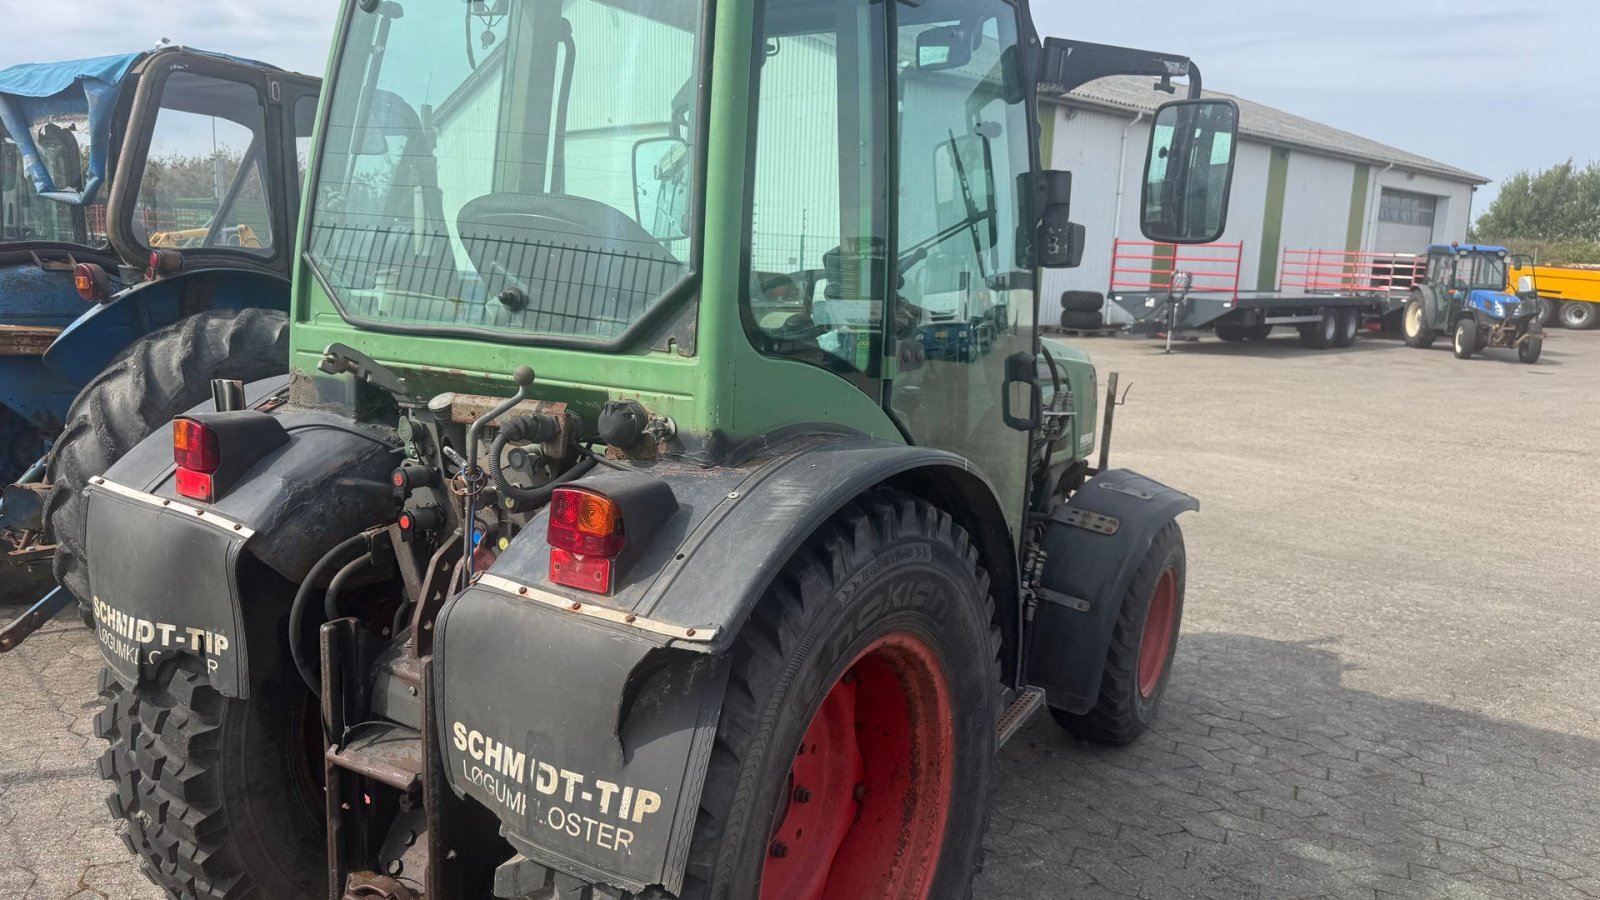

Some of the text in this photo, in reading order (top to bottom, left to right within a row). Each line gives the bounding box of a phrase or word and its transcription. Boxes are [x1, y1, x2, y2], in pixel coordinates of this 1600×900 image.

[93, 595, 229, 656] SCHMIDT-TIP
[453, 721, 661, 823] SCHMIDT-TIP
[463, 761, 635, 856] LØGUMOSTER
